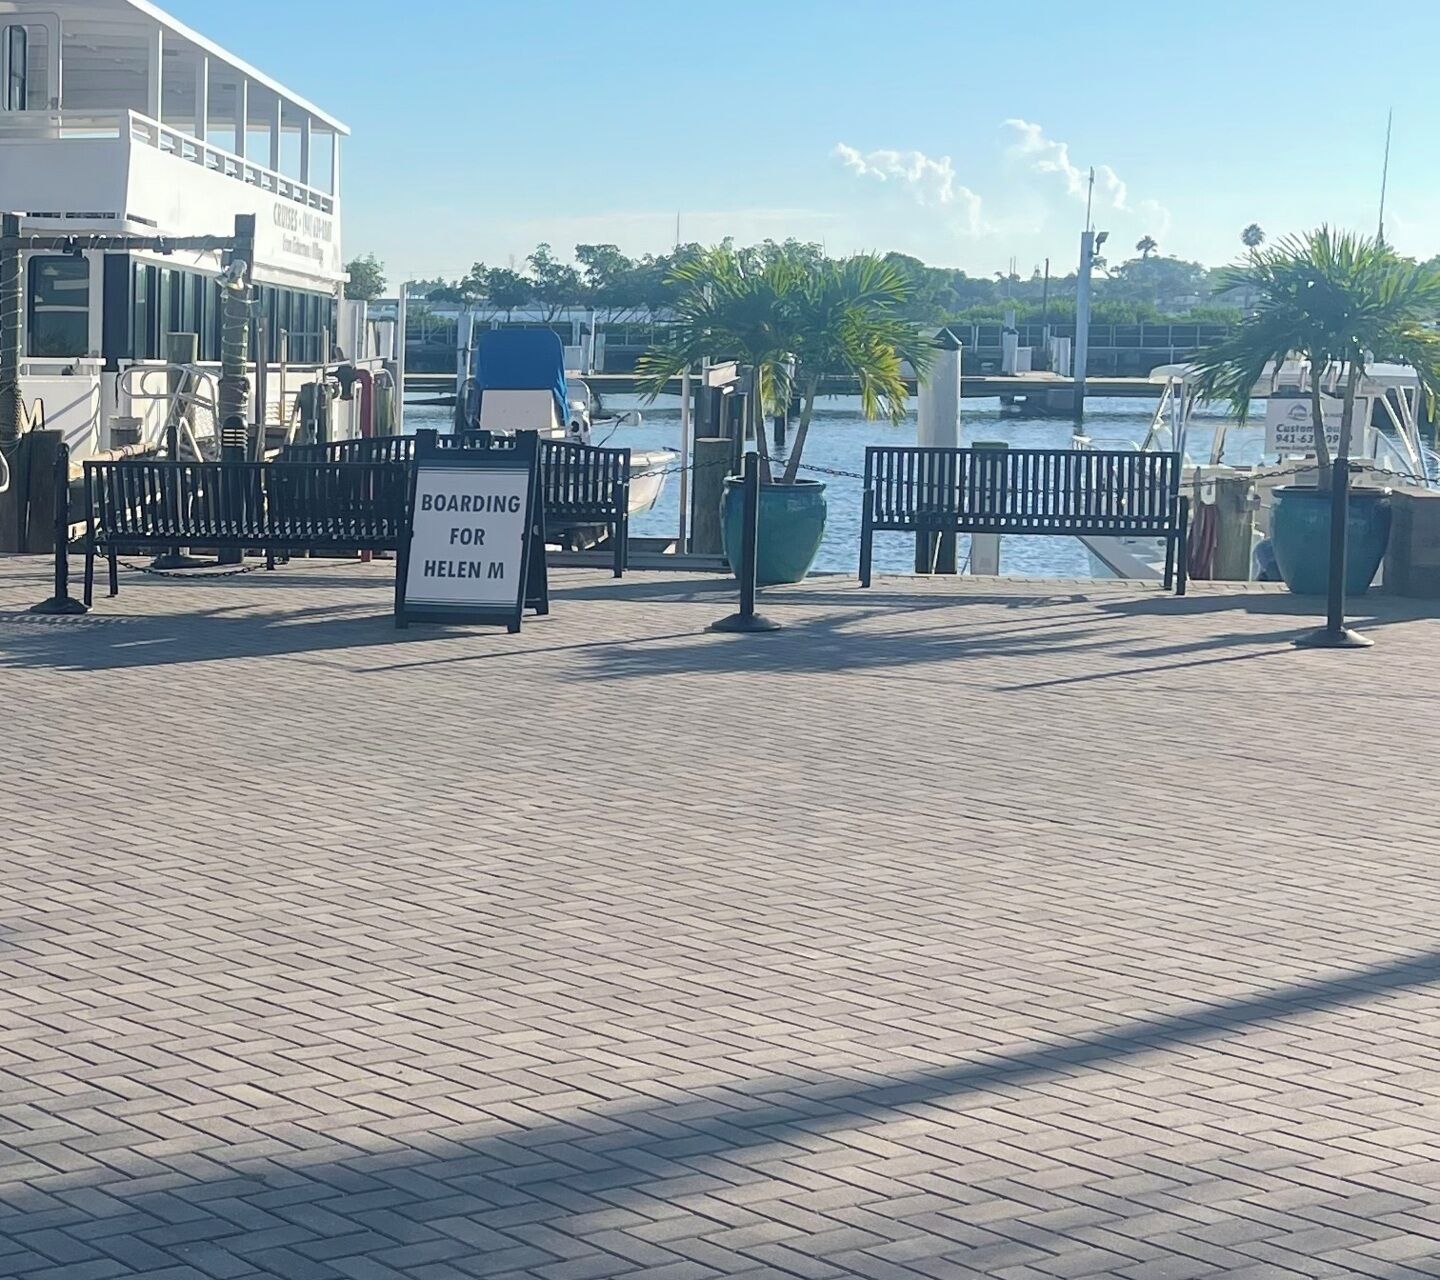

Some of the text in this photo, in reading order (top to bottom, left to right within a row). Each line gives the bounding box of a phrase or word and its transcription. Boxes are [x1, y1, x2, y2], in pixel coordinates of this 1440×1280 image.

[421, 493, 521, 513] BOARDING
[449, 527, 486, 546] FOR
[423, 559, 504, 579] HELEN M
